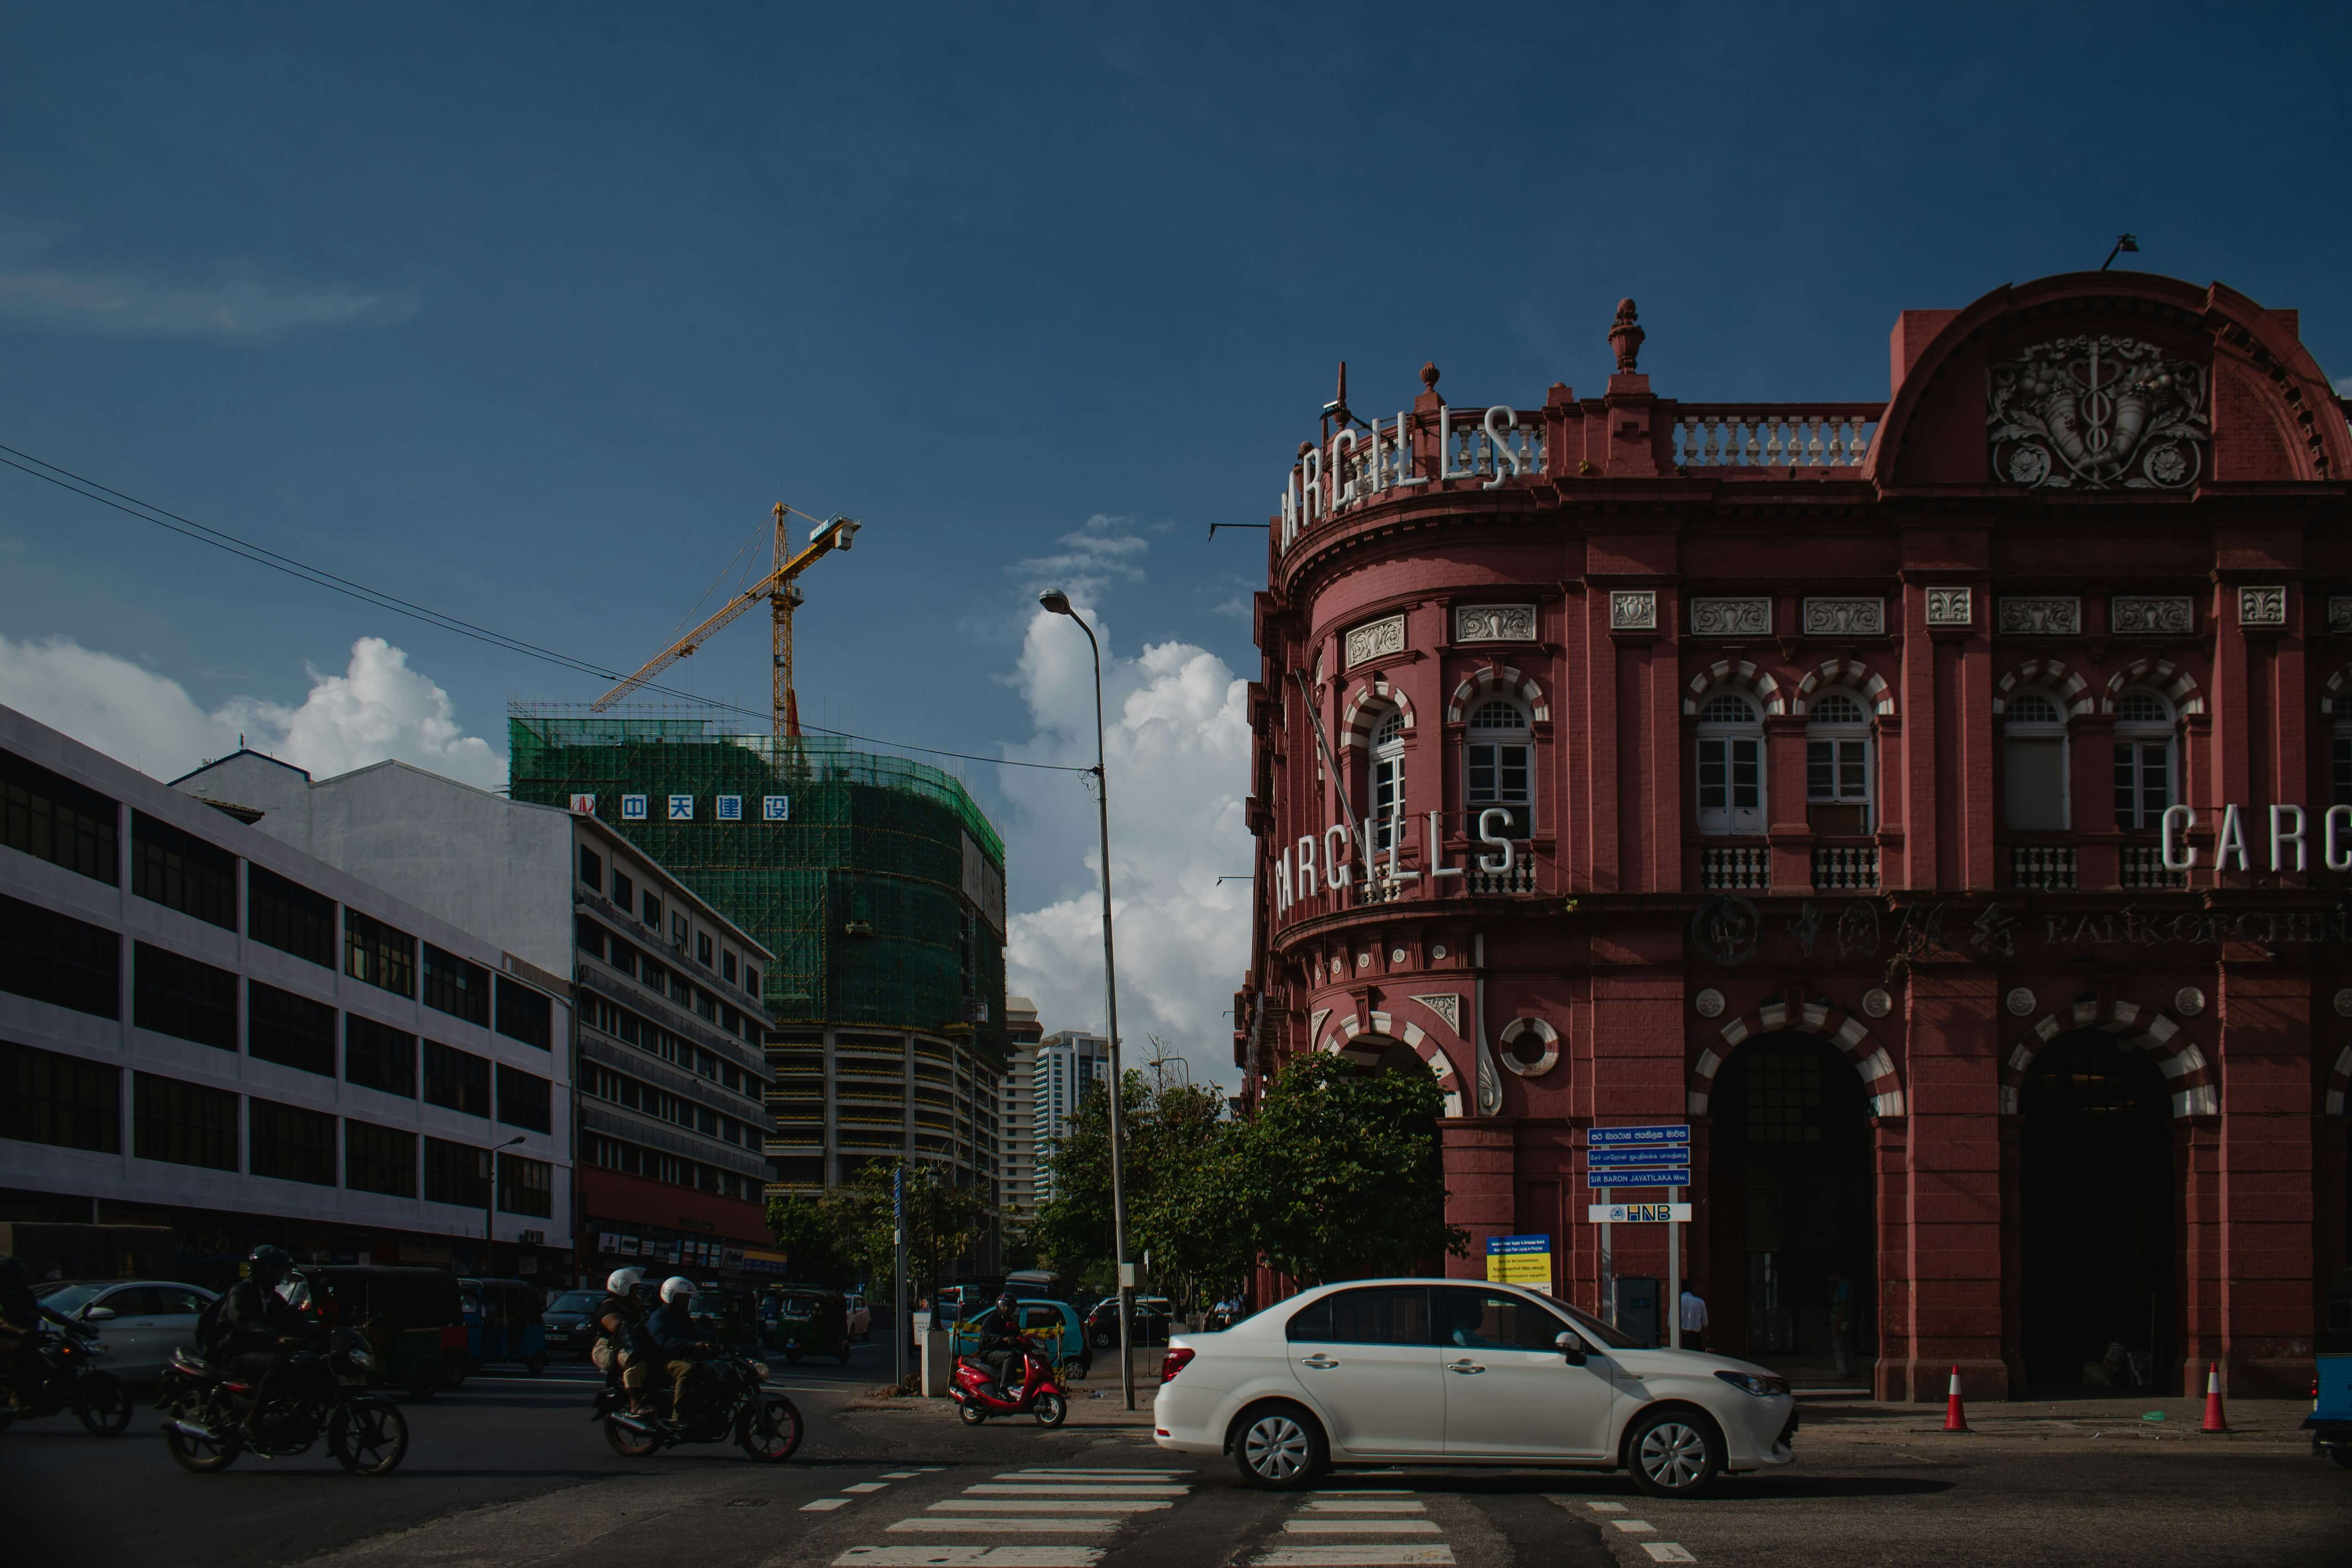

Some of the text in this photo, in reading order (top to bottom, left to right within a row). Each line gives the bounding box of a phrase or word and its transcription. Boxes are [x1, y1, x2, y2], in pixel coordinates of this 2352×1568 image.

[624, 797, 786, 819] 中天建设
[1627, 1205, 1670, 1221] HNB
